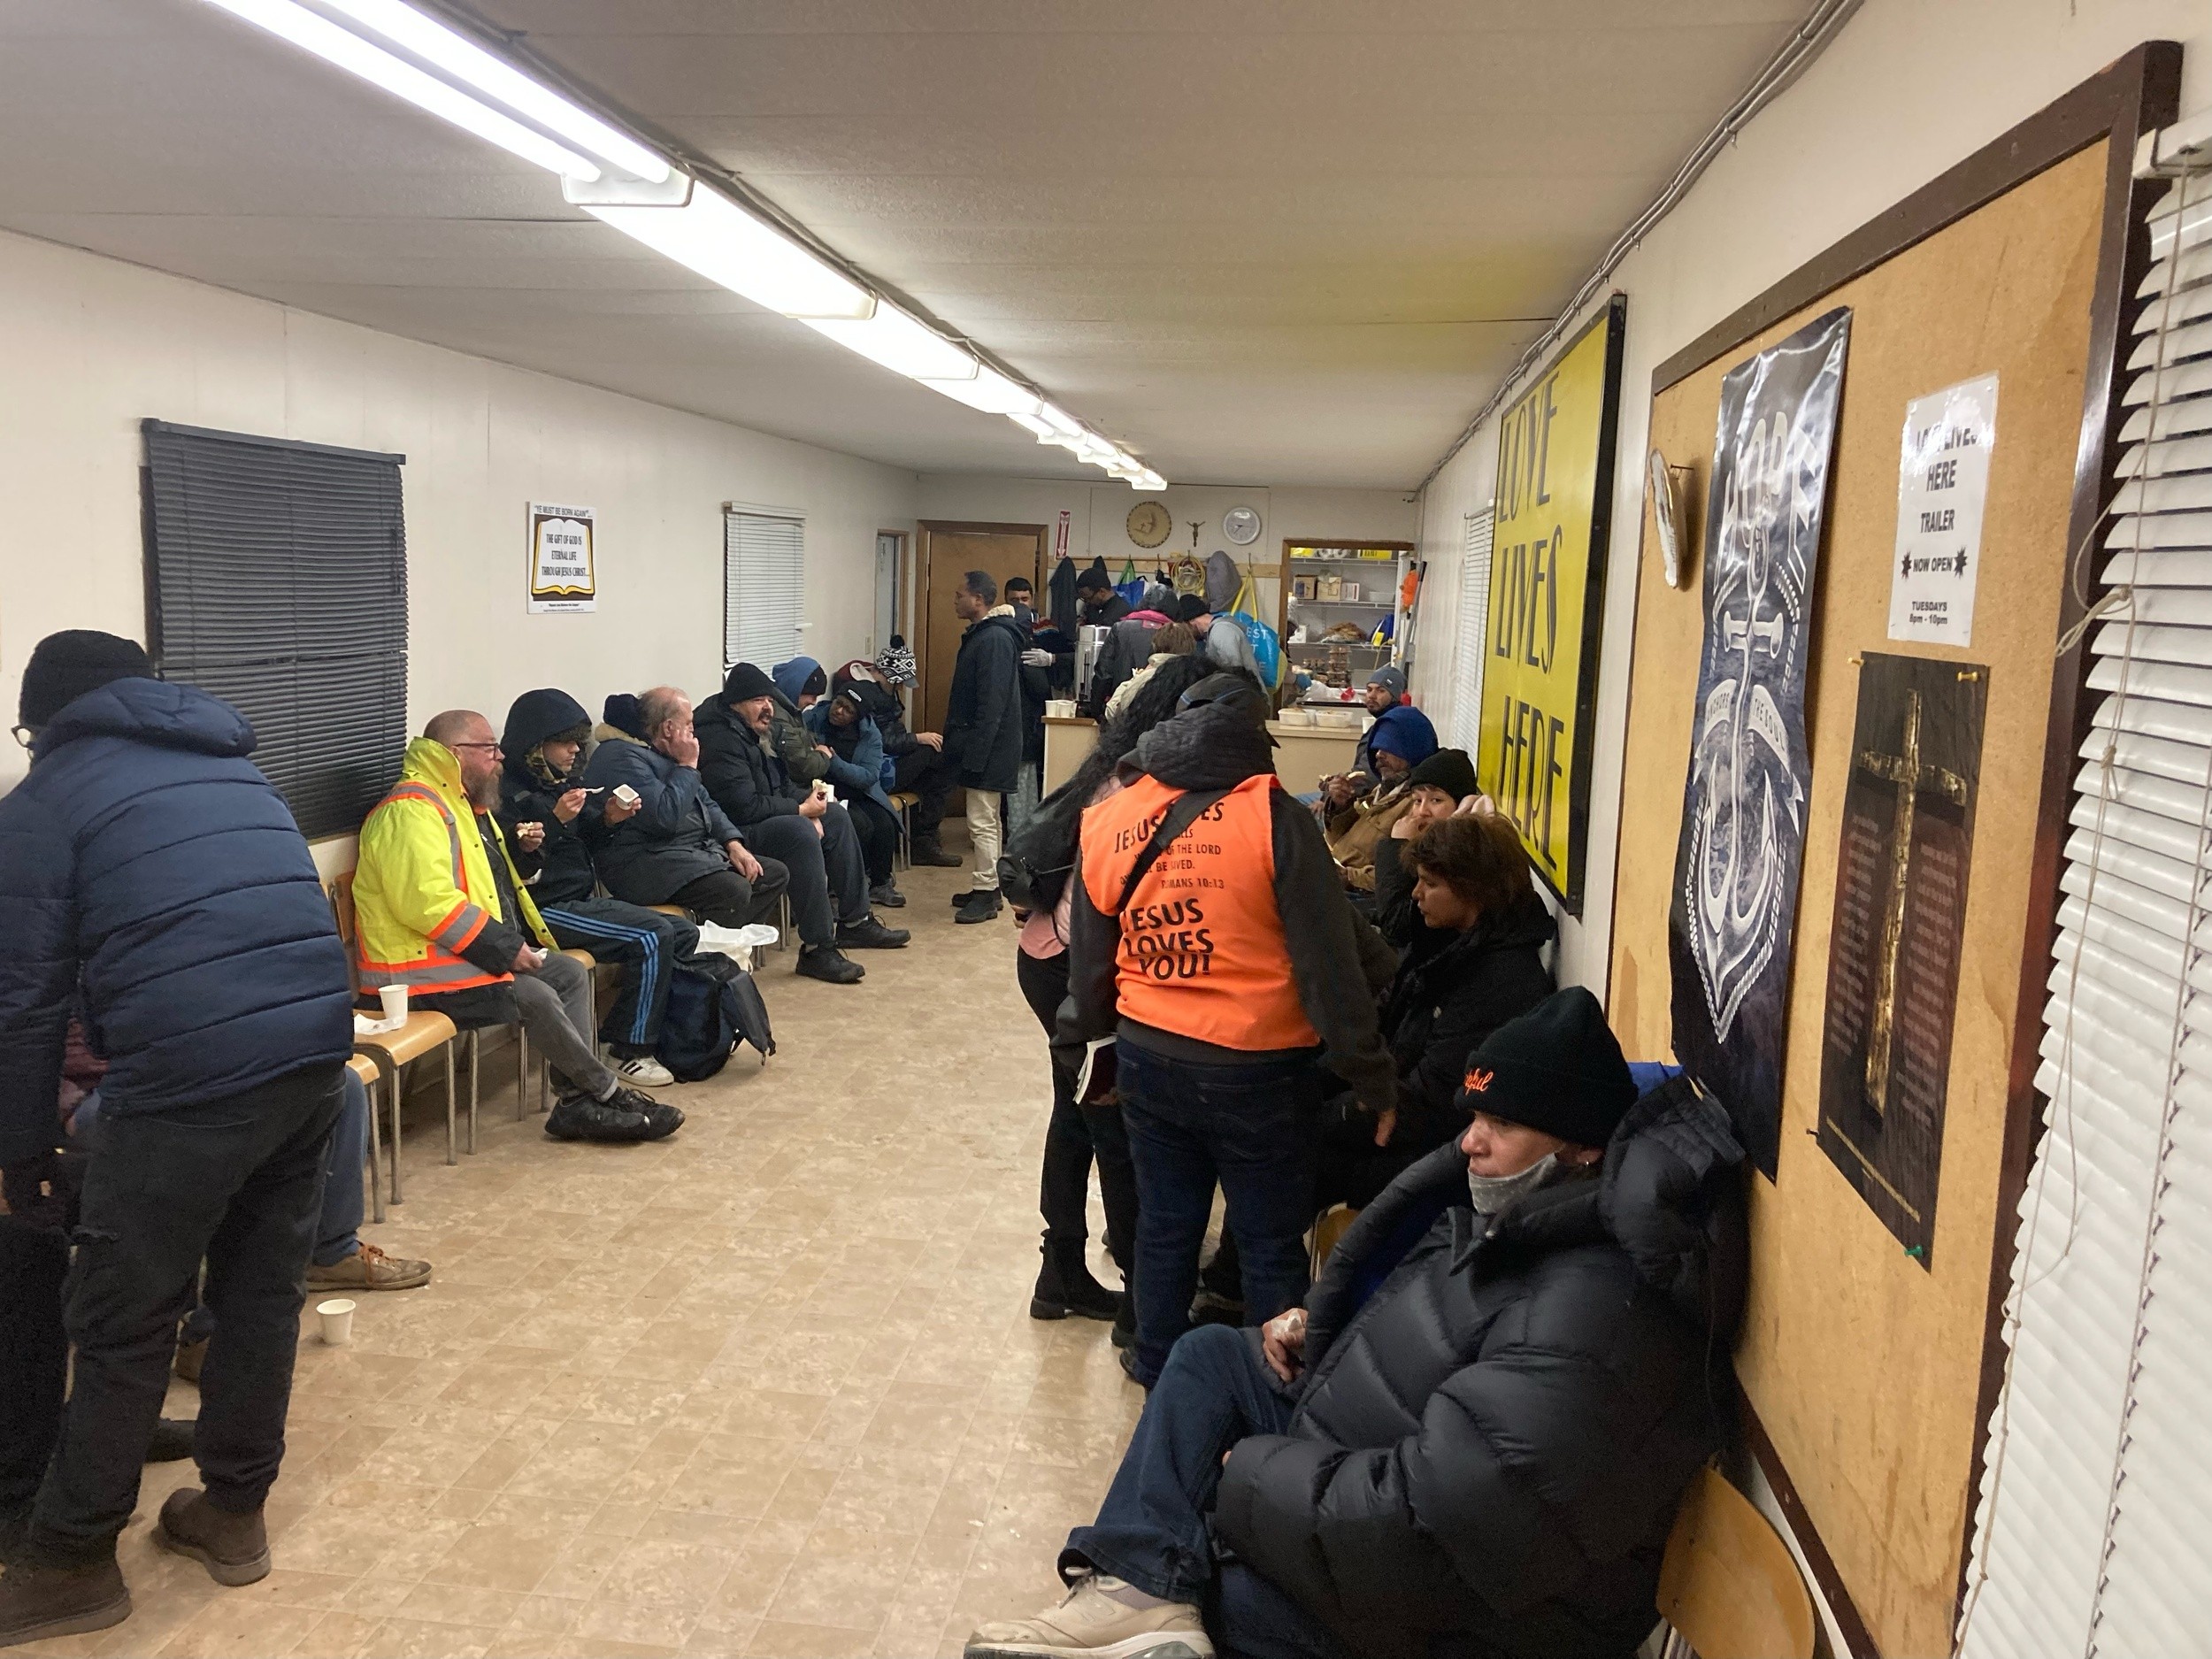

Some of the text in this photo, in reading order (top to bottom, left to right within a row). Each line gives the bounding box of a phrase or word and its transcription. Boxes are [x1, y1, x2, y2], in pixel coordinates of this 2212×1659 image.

[1499, 371, 1560, 524] LOVE
[1926, 459, 1957, 492] HERE
[1920, 509, 1955, 533] TRAILER
[554, 534, 563, 544] GIFT
[563, 534, 569, 545] OF
[569, 535, 578, 545] GOD
[578, 536, 582, 546] IS
[551, 549, 577, 561] ETERNAL LIFE
[541, 565, 561, 576] THROUGH
[561, 566, 572, 578] JESUS
[1912, 557, 1954, 572] NOW OPEN
[1495, 524, 1563, 675] LIVES
[1911, 601, 1947, 612] TUESDAYS
[1929, 613, 1948, 626] 10pm
[1764, 708, 1786, 752] SOUL
[1498, 695, 1565, 872] HERE
[1177, 843, 1193, 855] THE
[1196, 843, 1222, 856] LORD
[1156, 861, 1168, 872] BE
[1161, 878, 1225, 889] RMANS 10:13
[1123, 928, 1215, 958] LOVES
[1138, 953, 1210, 981] YOU!
